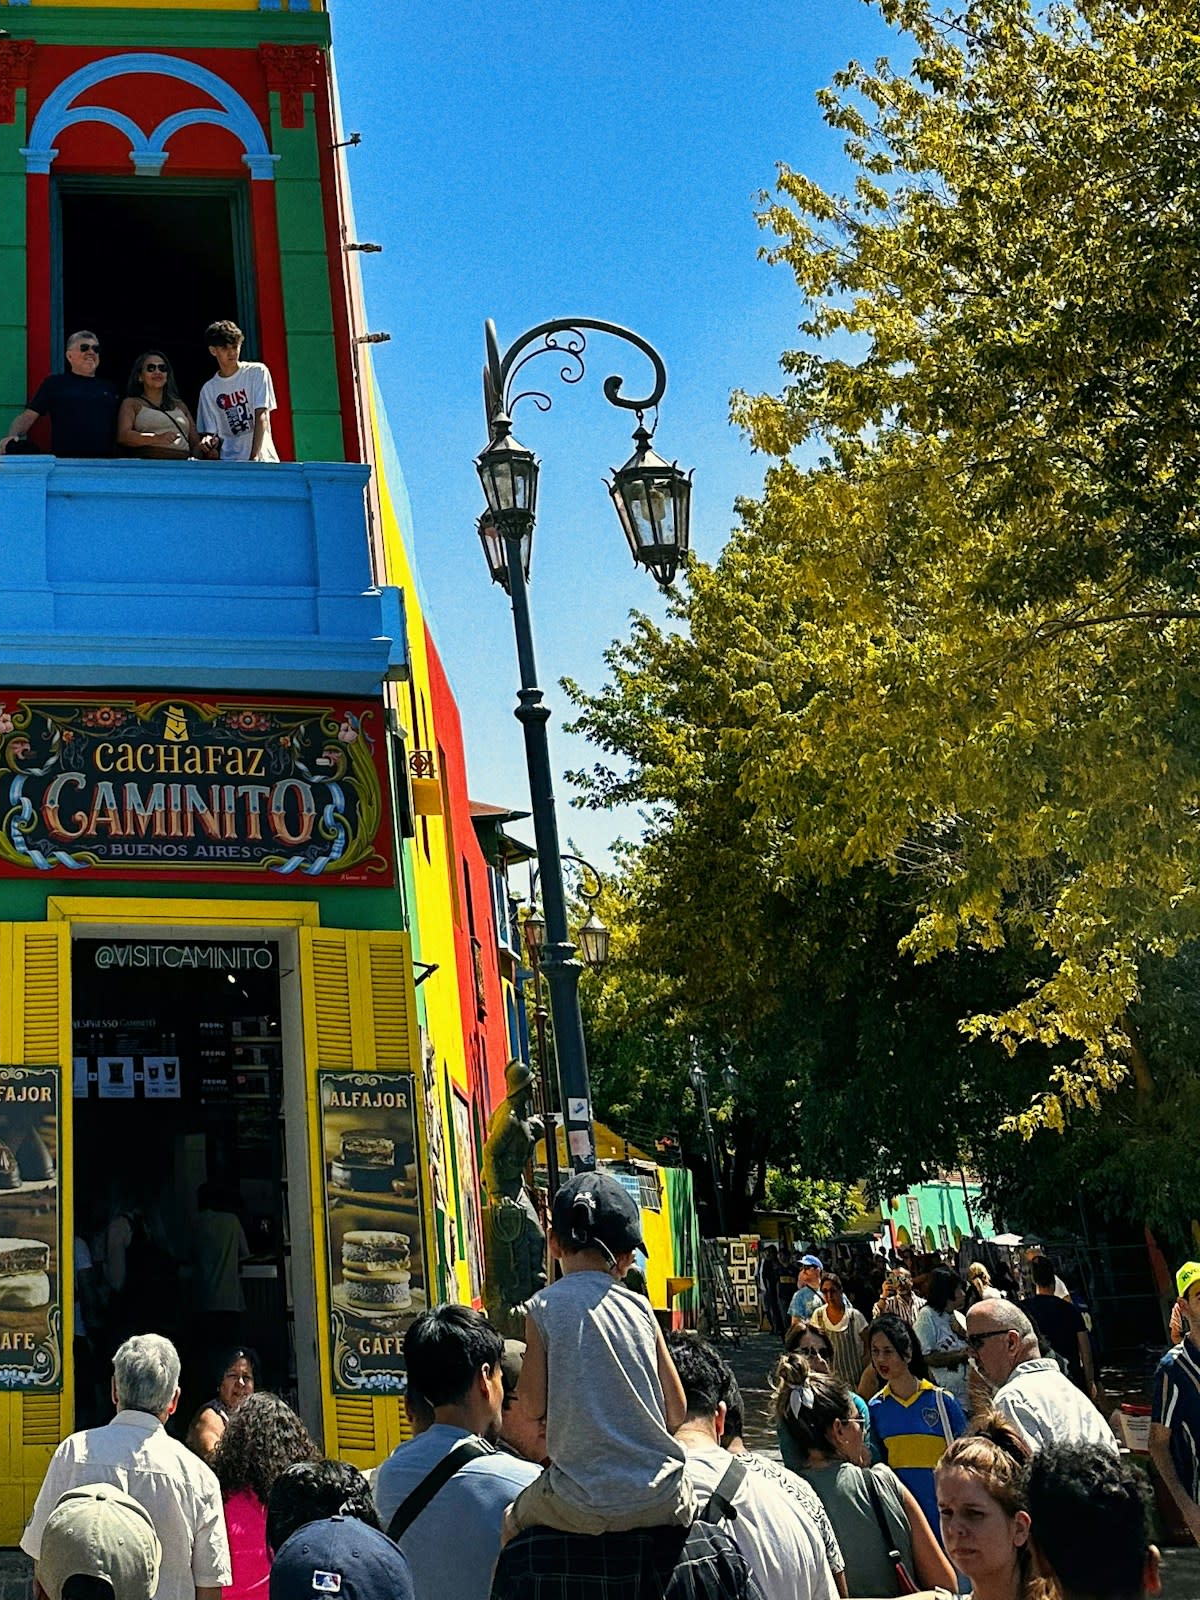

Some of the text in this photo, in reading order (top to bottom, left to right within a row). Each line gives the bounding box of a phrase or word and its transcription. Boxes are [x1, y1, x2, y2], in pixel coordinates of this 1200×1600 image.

[42, 772, 316, 845] CAMINITO
[110, 843, 251, 860] BUENOS AIRES
[94, 945, 273, 970] @VISITCAMINITO
[329, 1091, 408, 1109] ALFAJOR
[358, 1336, 406, 1356] CAFE
